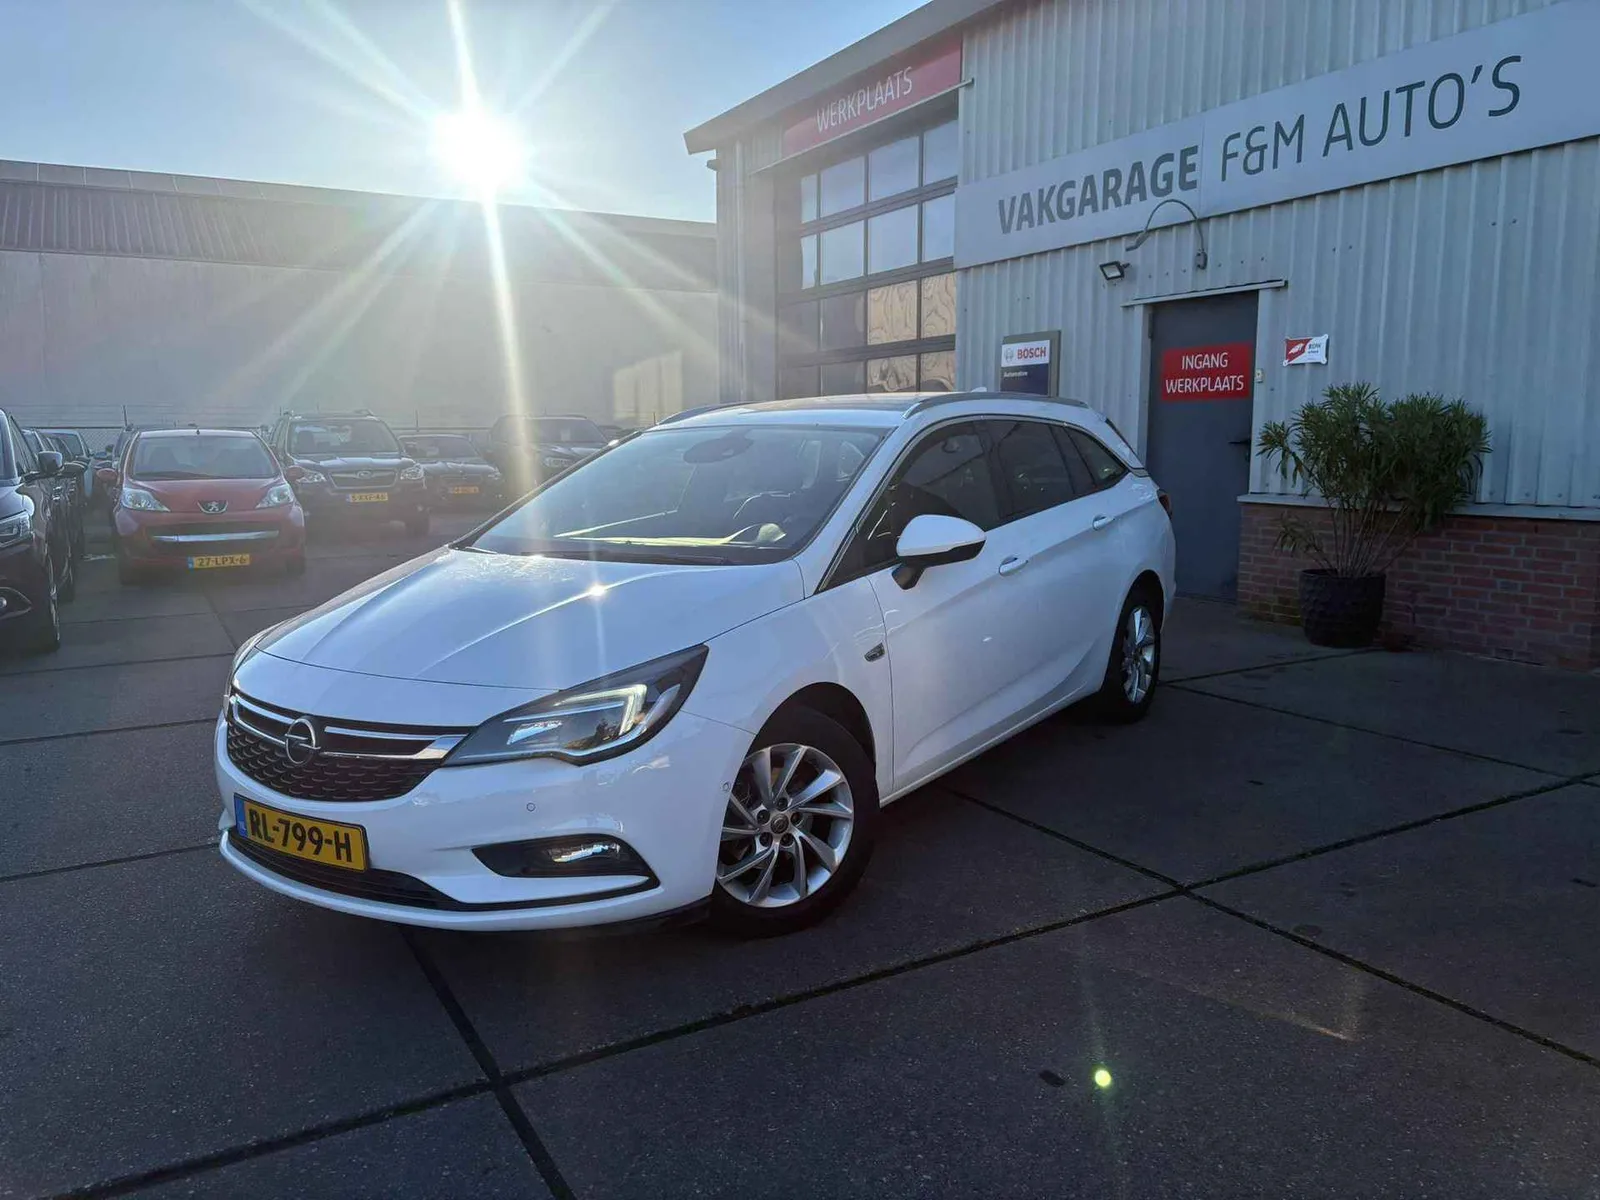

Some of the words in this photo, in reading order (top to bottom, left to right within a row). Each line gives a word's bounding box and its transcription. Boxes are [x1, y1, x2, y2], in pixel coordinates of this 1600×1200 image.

[816, 66, 913, 134] WERKPLAATS
[998, 145, 1200, 235] VAKGARAGE
[1221, 114, 1305, 182] F&M
[1322, 55, 1522, 157] AUTO'S
[1017, 346, 1047, 360] BOSCH
[1181, 351, 1229, 370] INGANG
[1165, 374, 1245, 394] WERKPLAATS
[248, 807, 353, 863] RL-799-H
